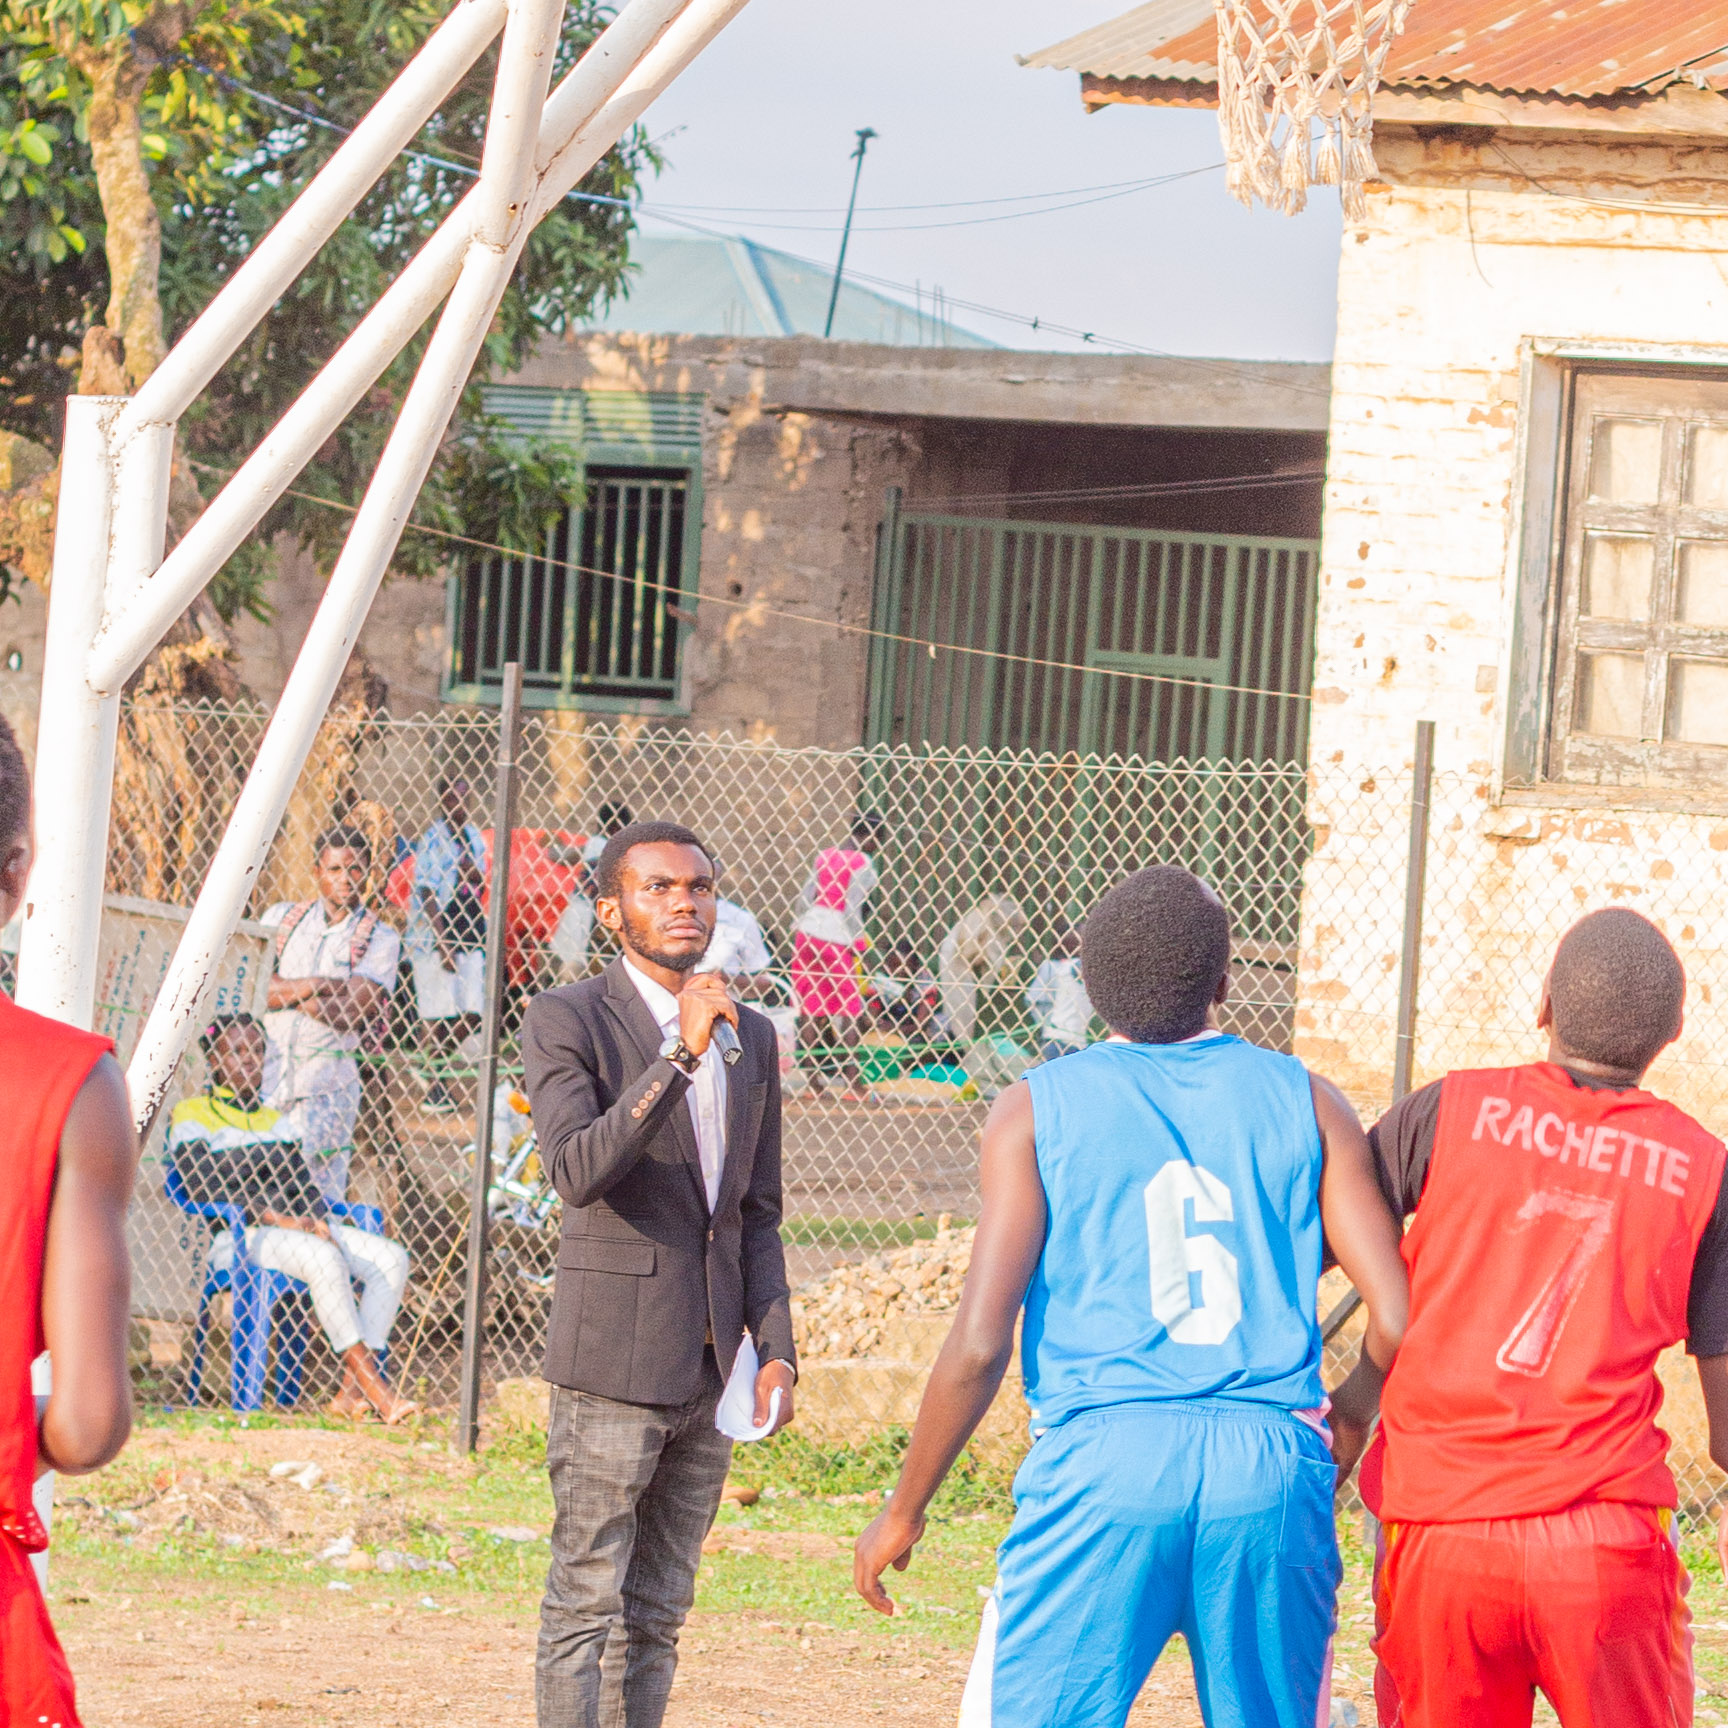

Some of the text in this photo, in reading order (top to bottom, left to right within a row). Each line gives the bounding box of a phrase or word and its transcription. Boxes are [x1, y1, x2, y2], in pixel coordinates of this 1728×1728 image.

[1471, 1095, 1691, 1197] RACHETTE
[1143, 1159, 1242, 1345] 6
[1496, 1186, 1614, 1377] 7
